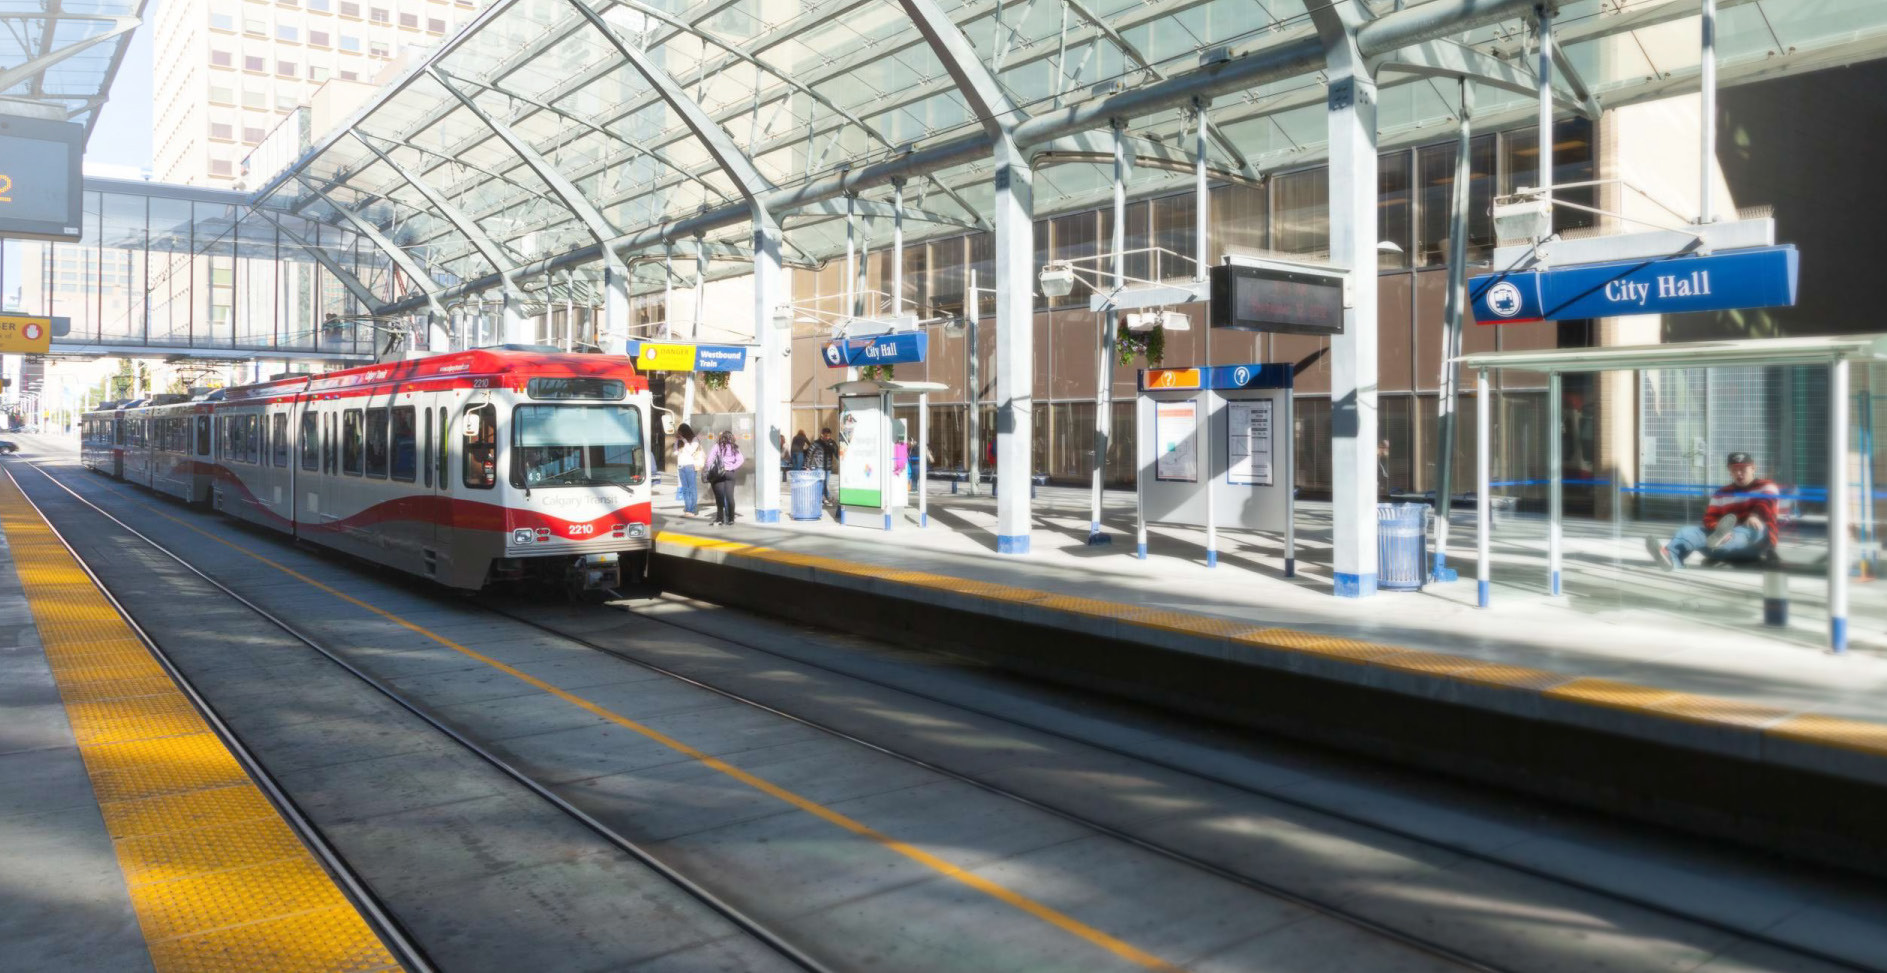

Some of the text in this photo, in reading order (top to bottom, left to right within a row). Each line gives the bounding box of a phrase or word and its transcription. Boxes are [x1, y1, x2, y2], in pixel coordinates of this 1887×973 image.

[1605, 270, 1711, 305] City Hall
[0, 322, 16, 331] ER
[701, 350, 741, 359] Westbound
[865, 342, 897, 360] City Hall
[473, 379, 489, 388] 2210
[542, 495, 618, 508] Calgary Transit
[569, 524, 593, 535] 2210
